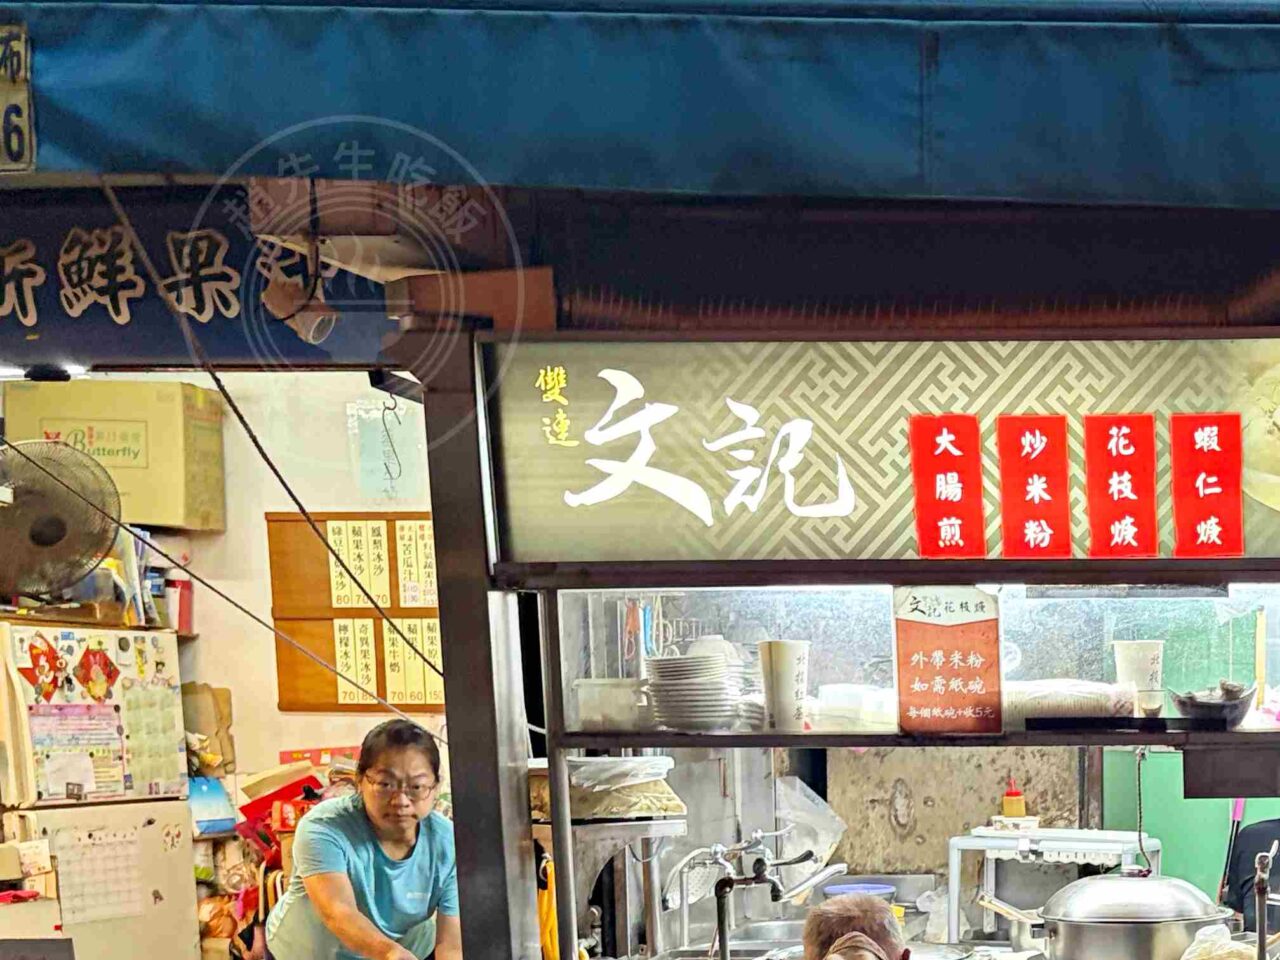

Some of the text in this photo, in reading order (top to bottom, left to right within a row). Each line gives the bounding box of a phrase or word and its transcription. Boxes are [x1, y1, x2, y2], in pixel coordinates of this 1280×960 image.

[563, 368, 856, 527] 文記
[934, 427, 964, 548] 大腸煎
[1020, 429, 1054, 549] 炒米粉
[910, 650, 986, 669] 外帶米粉
[910, 676, 987, 696] 如需紙碗
